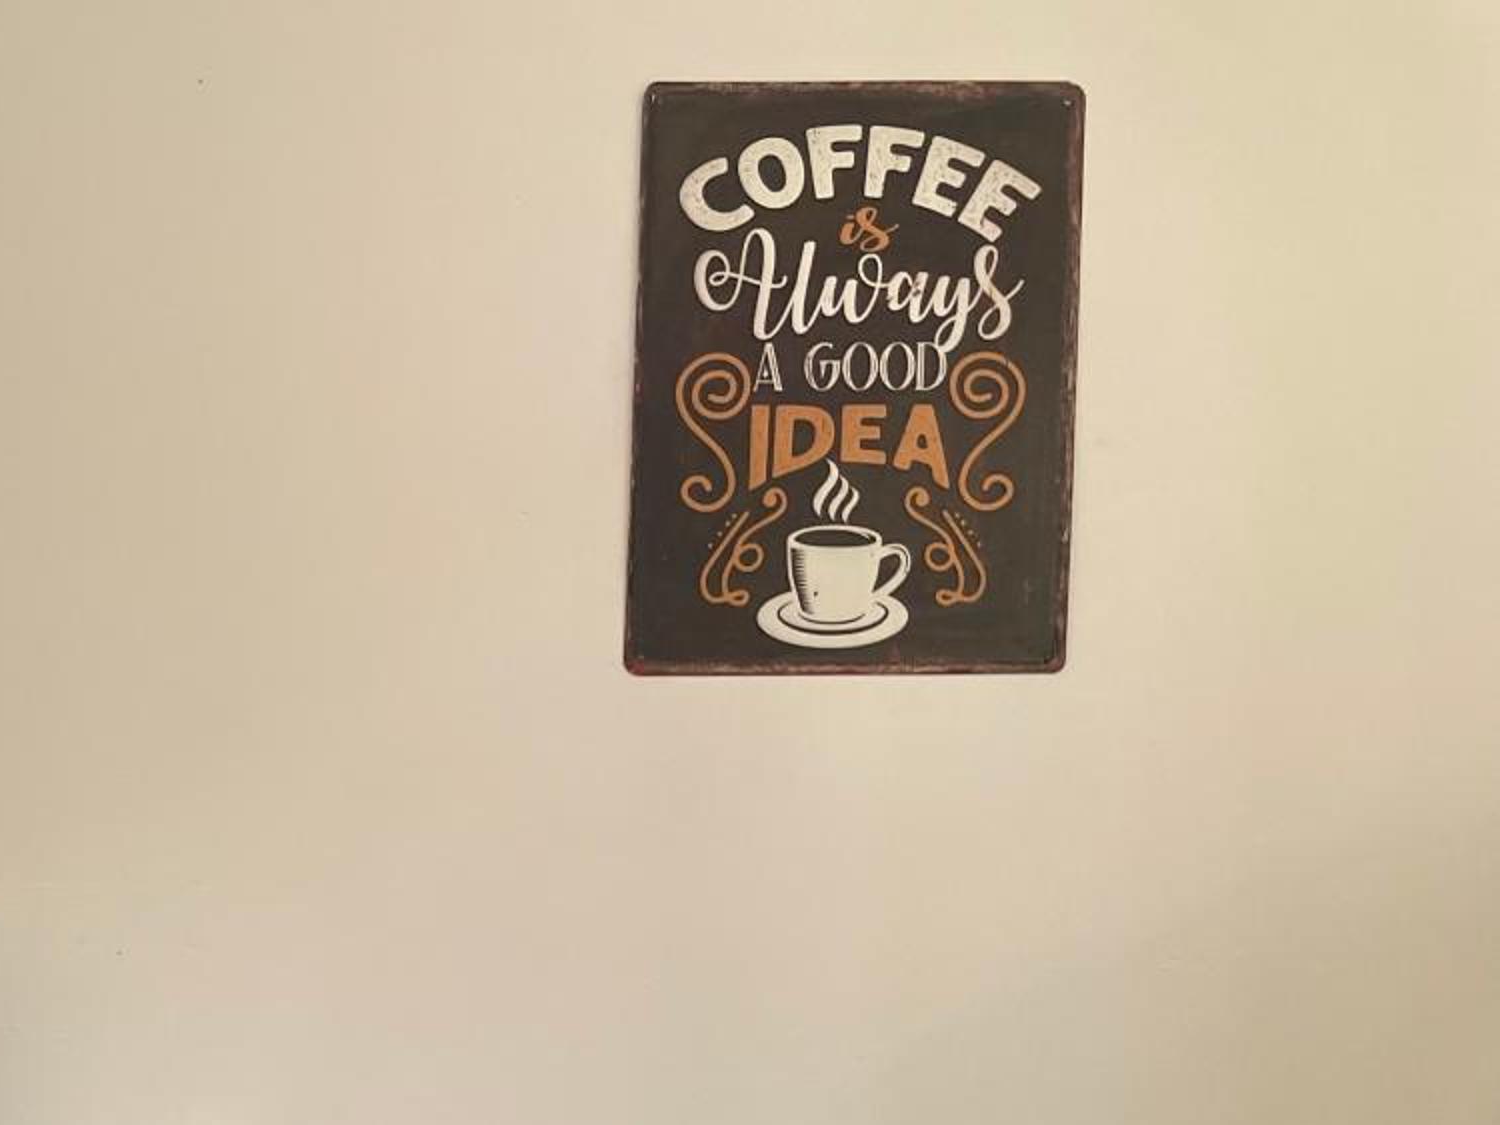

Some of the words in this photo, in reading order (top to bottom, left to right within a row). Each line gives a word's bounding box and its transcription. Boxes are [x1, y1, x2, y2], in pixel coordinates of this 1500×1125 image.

[679, 124, 1042, 242] COFFEE
[838, 207, 899, 252] is
[693, 227, 1025, 353] Always
[752, 342, 784, 393] A
[803, 341, 948, 393] GOOD
[747, 404, 950, 490] IDEA
